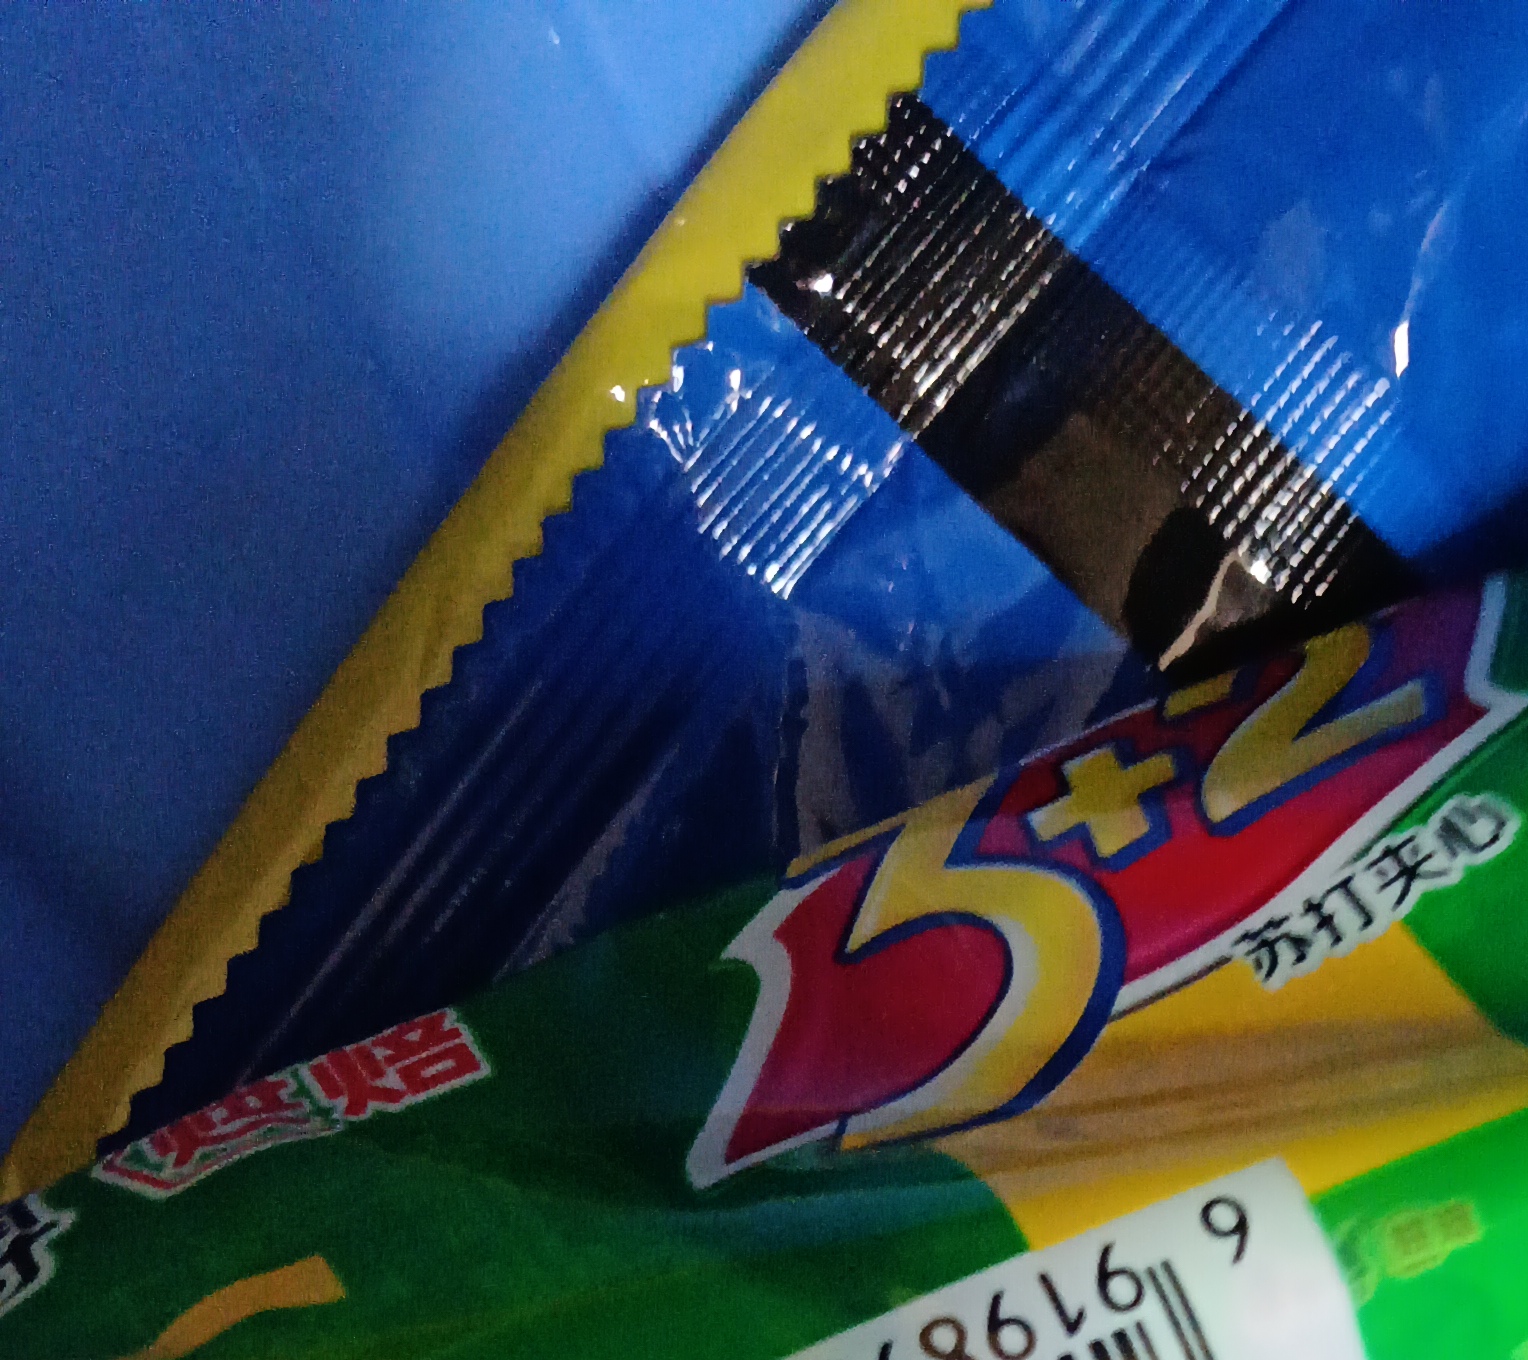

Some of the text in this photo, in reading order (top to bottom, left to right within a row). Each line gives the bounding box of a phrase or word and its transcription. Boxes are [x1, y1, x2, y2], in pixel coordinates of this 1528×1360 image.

[782, 622, 1434, 1150] 3+2
[1231, 800, 1508, 984] 苏打夹心
[1201, 1194, 1252, 1265] 6
